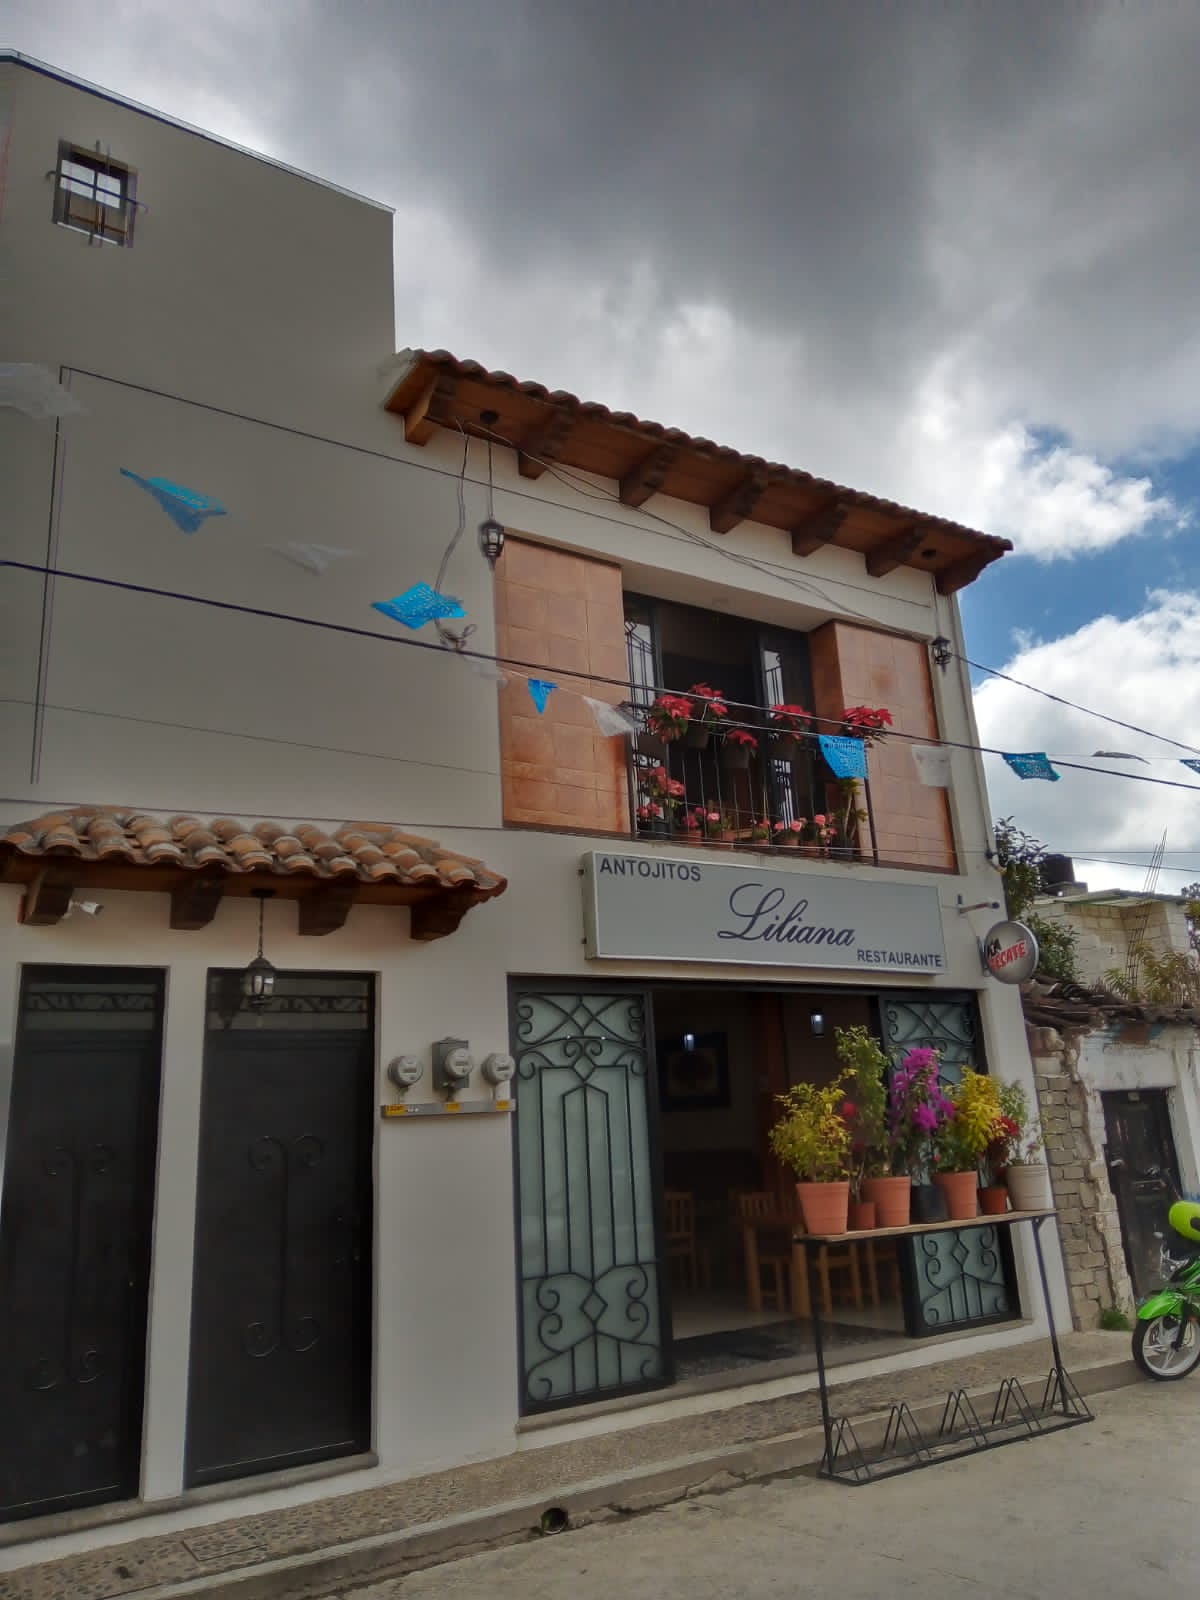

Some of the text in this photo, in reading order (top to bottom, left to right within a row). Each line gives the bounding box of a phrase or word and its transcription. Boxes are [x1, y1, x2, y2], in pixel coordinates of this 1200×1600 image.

[600, 857, 702, 882] ANTOJITOS
[717, 883, 855, 946] Liliana
[857, 948, 943, 968] RESTAURANTE
